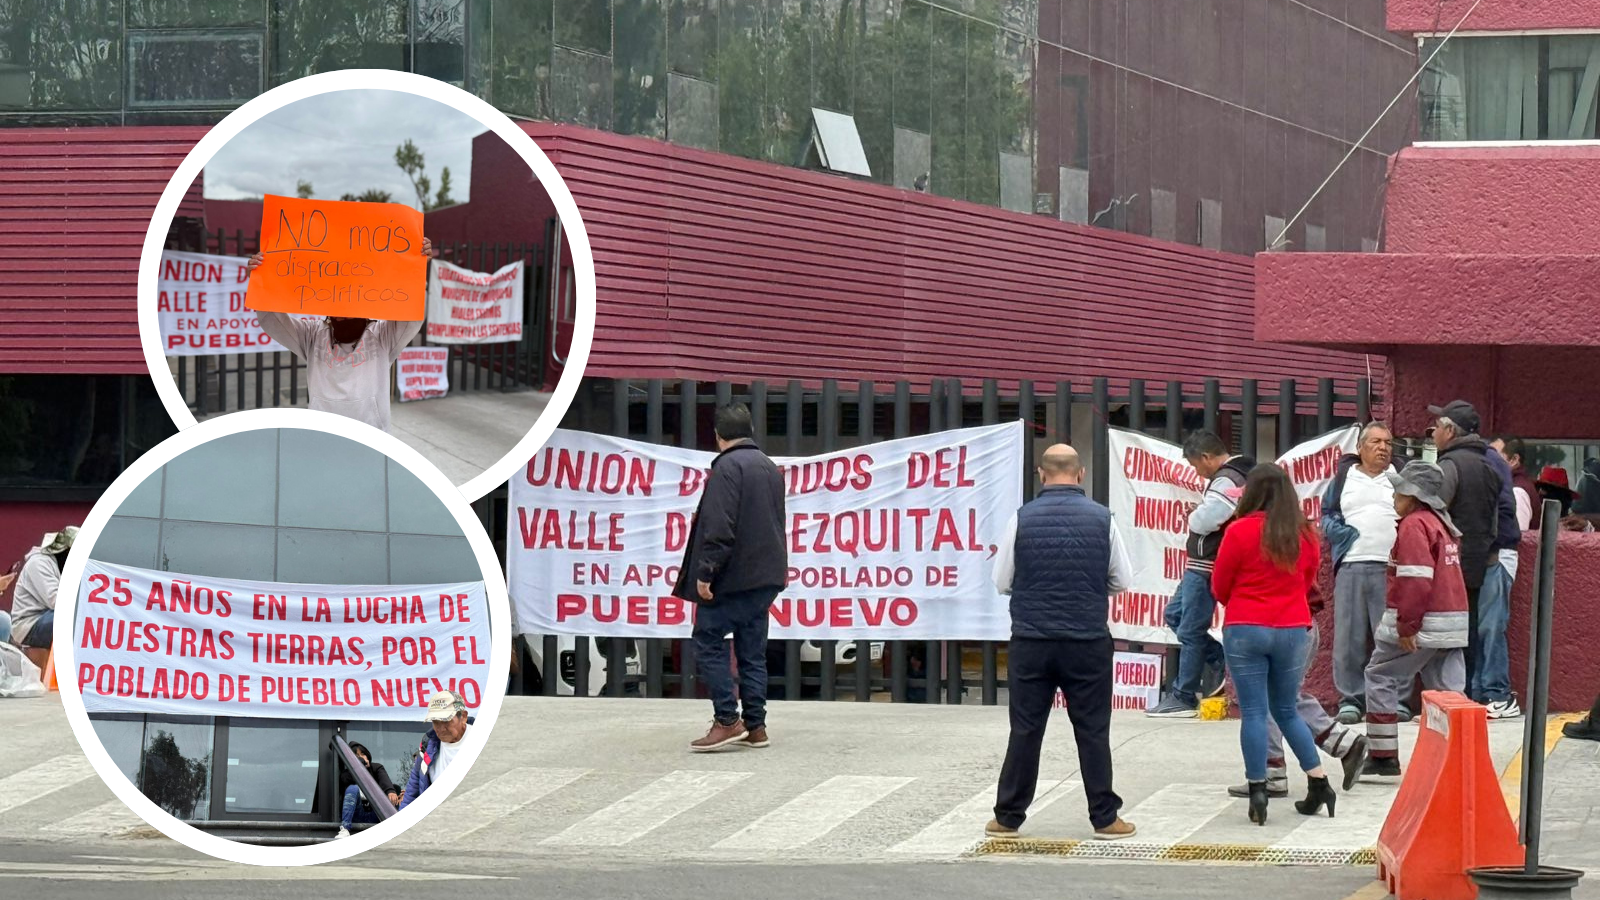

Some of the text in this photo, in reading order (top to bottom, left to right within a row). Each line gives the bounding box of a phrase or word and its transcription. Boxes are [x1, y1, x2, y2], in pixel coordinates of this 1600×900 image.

[275, 208, 328, 248] NO
[276, 250, 374, 284] disfraces
[157, 290, 208, 314] ALLE
[293, 284, 409, 310] políticos
[167, 331, 272, 350] PUEBLO
[176, 318, 199, 331] EN
[907, 446, 976, 489] DEL
[517, 506, 625, 552] VALLE
[790, 507, 999, 561] EZQUITAL,
[573, 563, 959, 588] EN APO POBLADO DE
[87, 573, 472, 625] 25 AÑOS EN LA LUCHA DE
[80, 615, 486, 671] NUESTRAS TIERRAS, POR EL
[77, 661, 210, 701] POBLADO
[217, 673, 251, 703] DE
[261, 675, 362, 707] PUEBLO
[1114, 661, 1156, 687] PUEBLO
